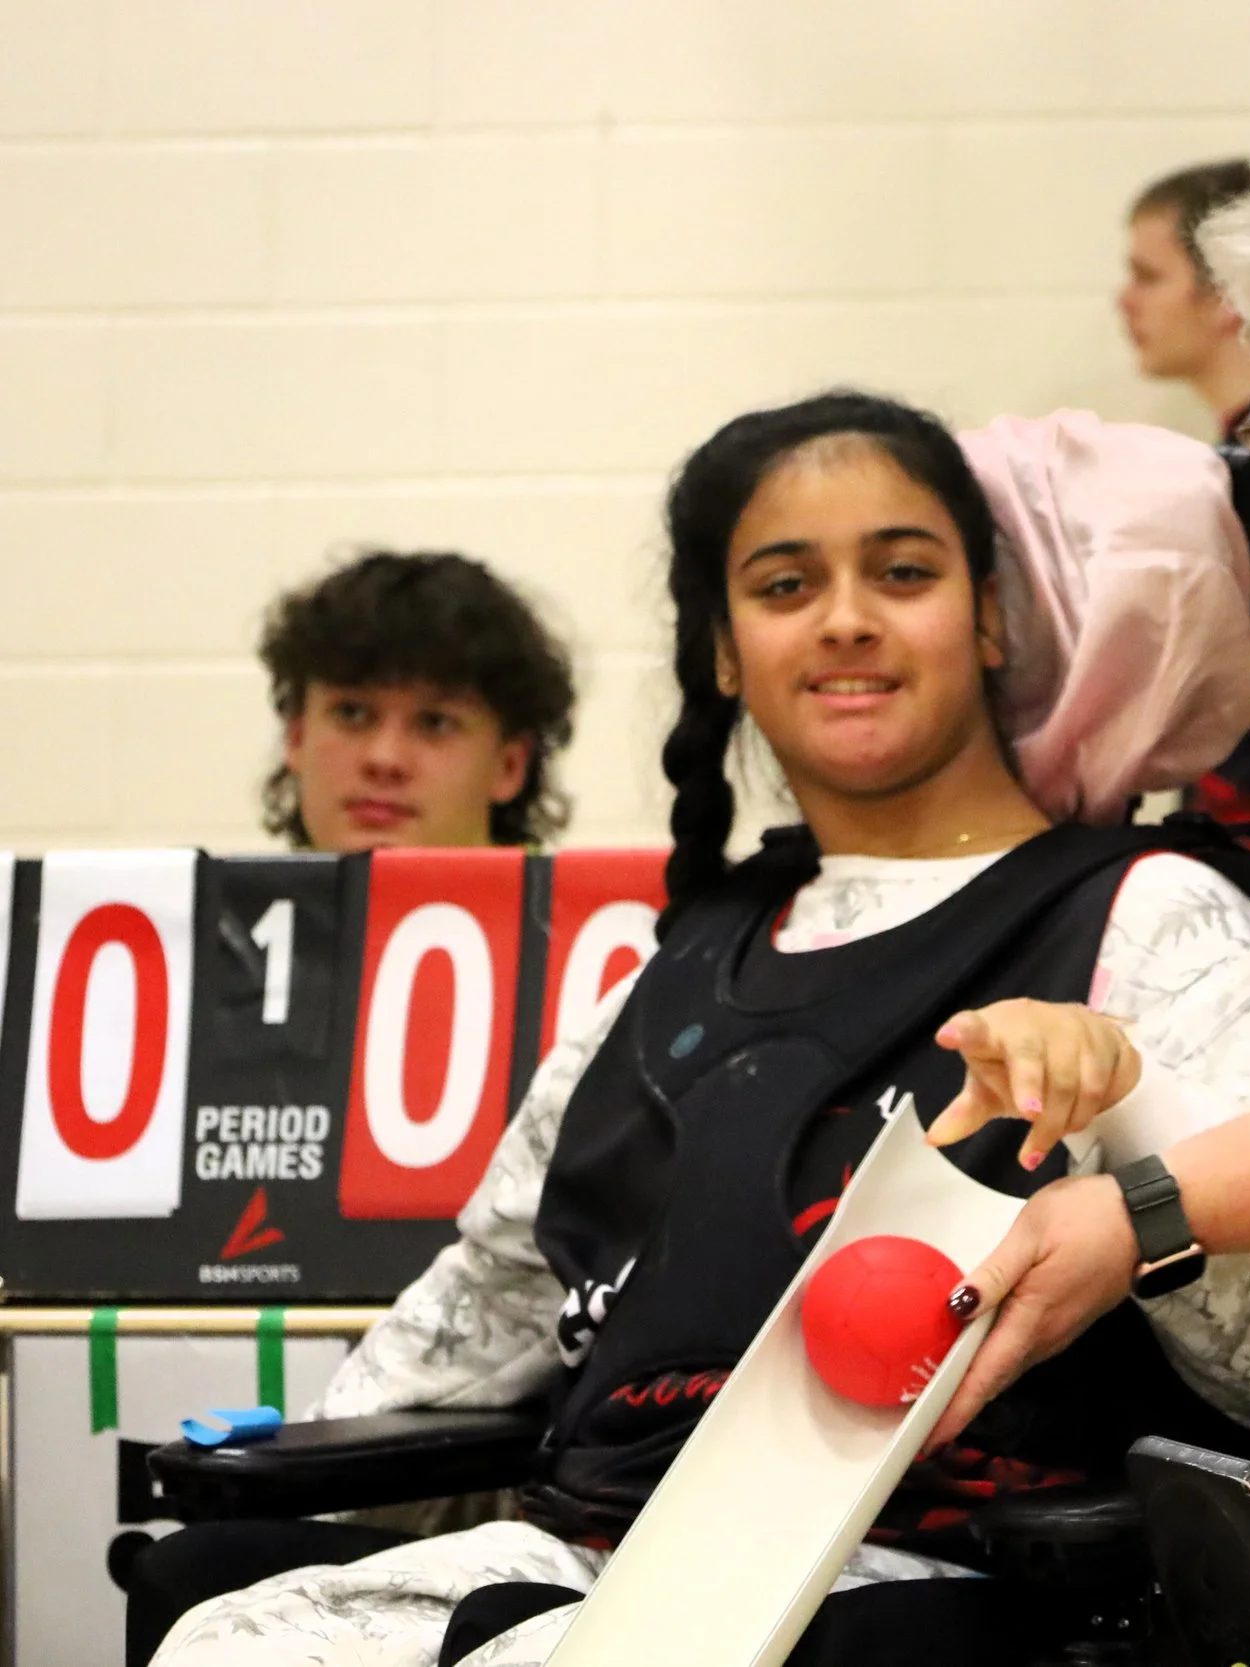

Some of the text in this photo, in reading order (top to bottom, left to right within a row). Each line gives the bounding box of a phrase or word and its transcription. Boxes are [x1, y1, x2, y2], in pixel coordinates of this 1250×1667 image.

[252, 900, 294, 1024] 1
[48, 901, 169, 1161] 0
[364, 901, 494, 1167] 0
[195, 1105, 331, 1142] PERIOD
[196, 1142, 323, 1180] GAMES
